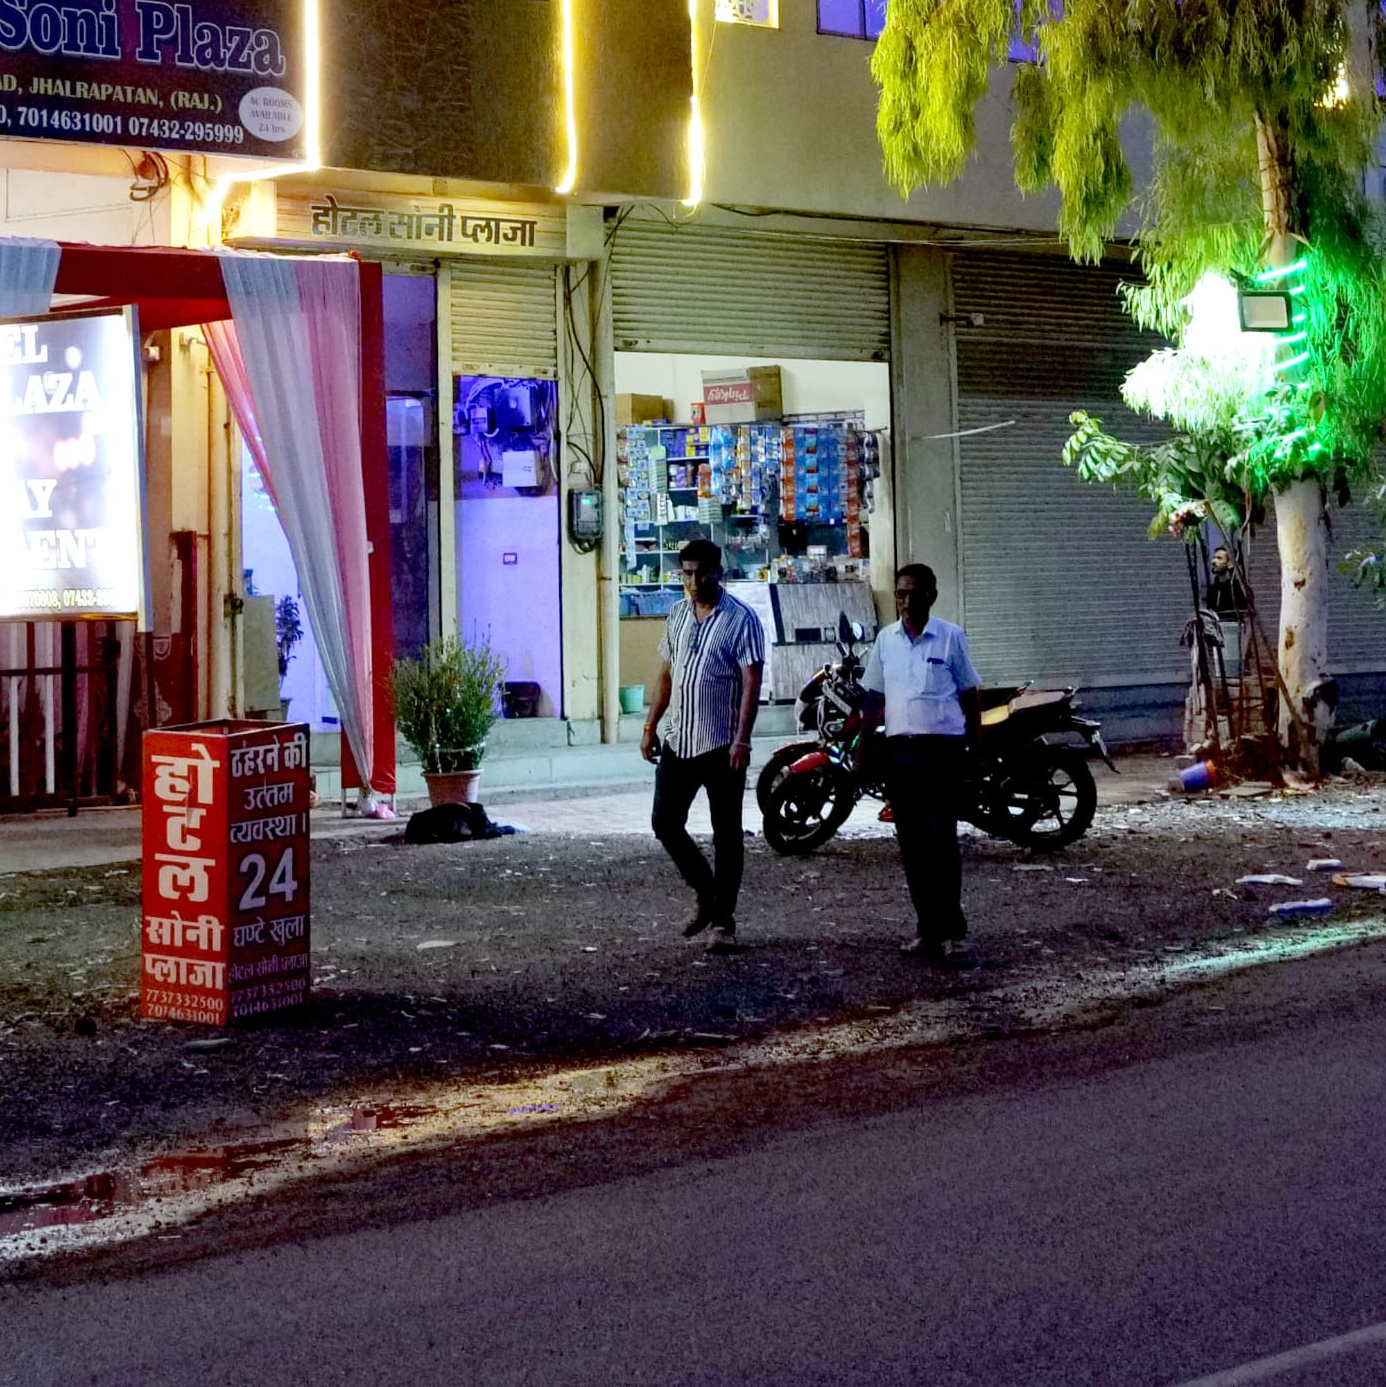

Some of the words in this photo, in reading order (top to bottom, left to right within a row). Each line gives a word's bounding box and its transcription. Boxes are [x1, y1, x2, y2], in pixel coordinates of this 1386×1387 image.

[135, 0, 286, 77] Plaza
[29, 76, 163, 107] JHALRAPATAN,
[171, 92, 223, 114] (RAJ.)
[18, 107, 122, 134] 7014631001
[129, 118, 244, 144] 07432-295999
[311, 195, 385, 236] होटल
[388, 203, 456, 242] सोनी
[461, 215, 538, 247] प्लाजा
[284, 731, 308, 770] की
[151, 743, 221, 903] होटल
[238, 847, 299, 911] 24
[145, 910, 225, 952] सोनी
[270, 914, 305, 947] खुला
[144, 953, 226, 990] प्लाजा
[146, 988, 224, 1011] 7737332500
[148, 1003, 220, 1025] 7014631001
